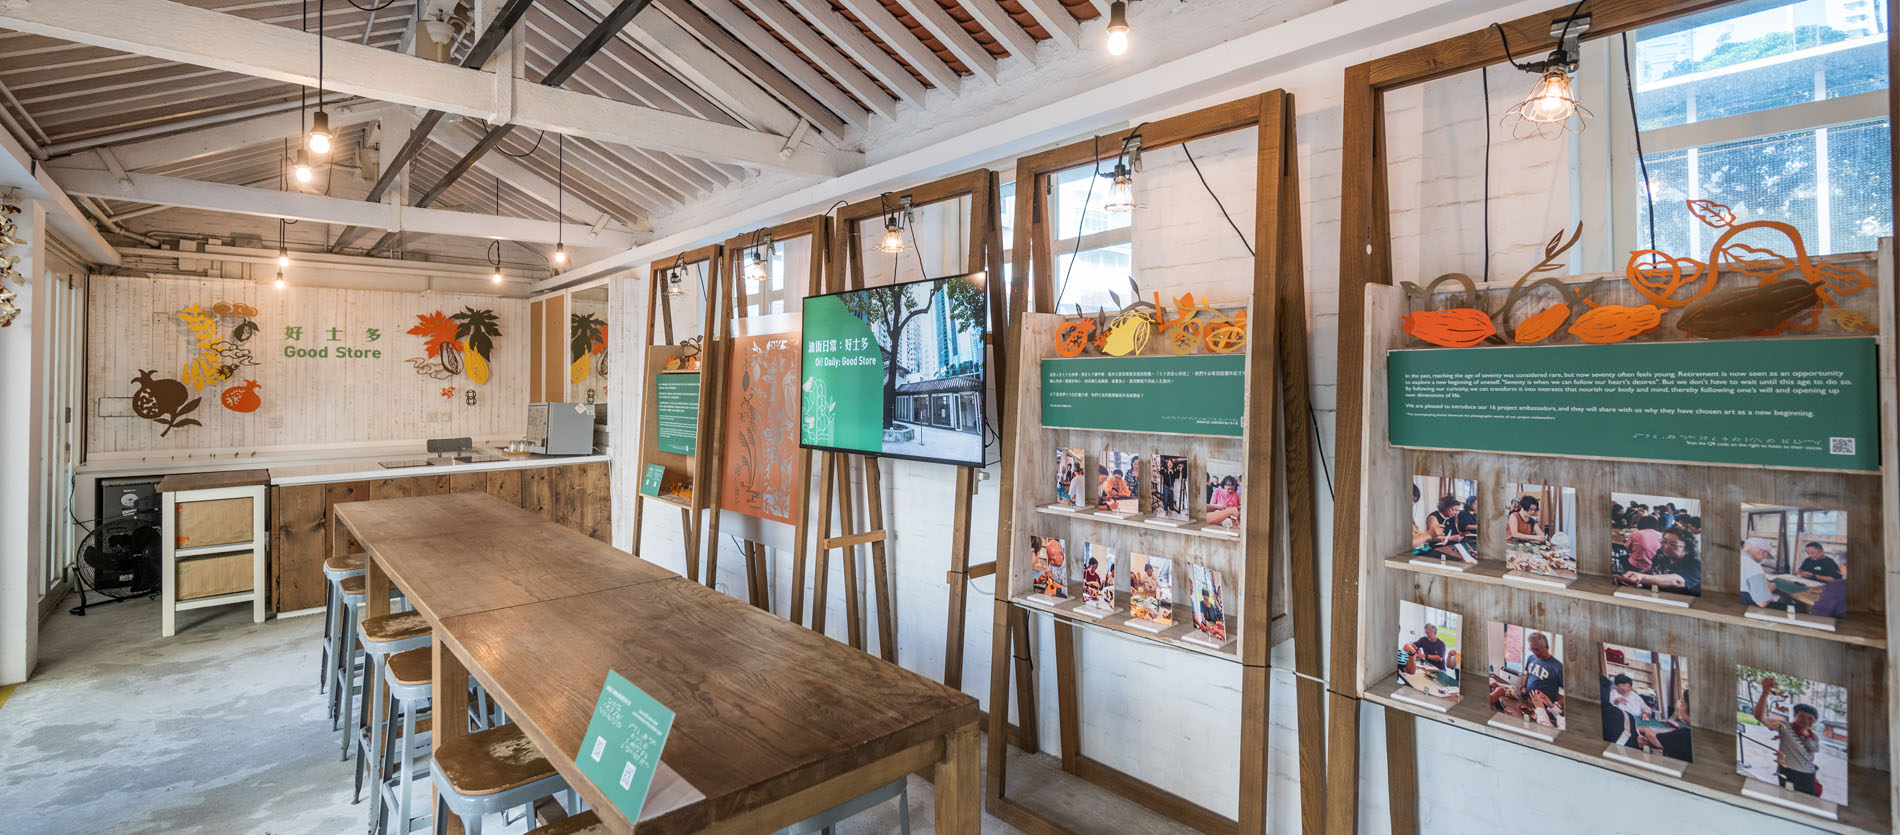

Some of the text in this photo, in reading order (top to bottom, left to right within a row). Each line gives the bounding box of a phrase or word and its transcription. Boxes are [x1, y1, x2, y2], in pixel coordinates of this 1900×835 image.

[285, 325, 381, 342] 好士多
[284, 345, 382, 359] Good Store
[824, 357, 841, 368] Daily:
[842, 356, 857, 366] Good
[858, 355, 877, 366] Store
[1700, 387, 1735, 395] following
[1527, 663, 1549, 680] GAP
